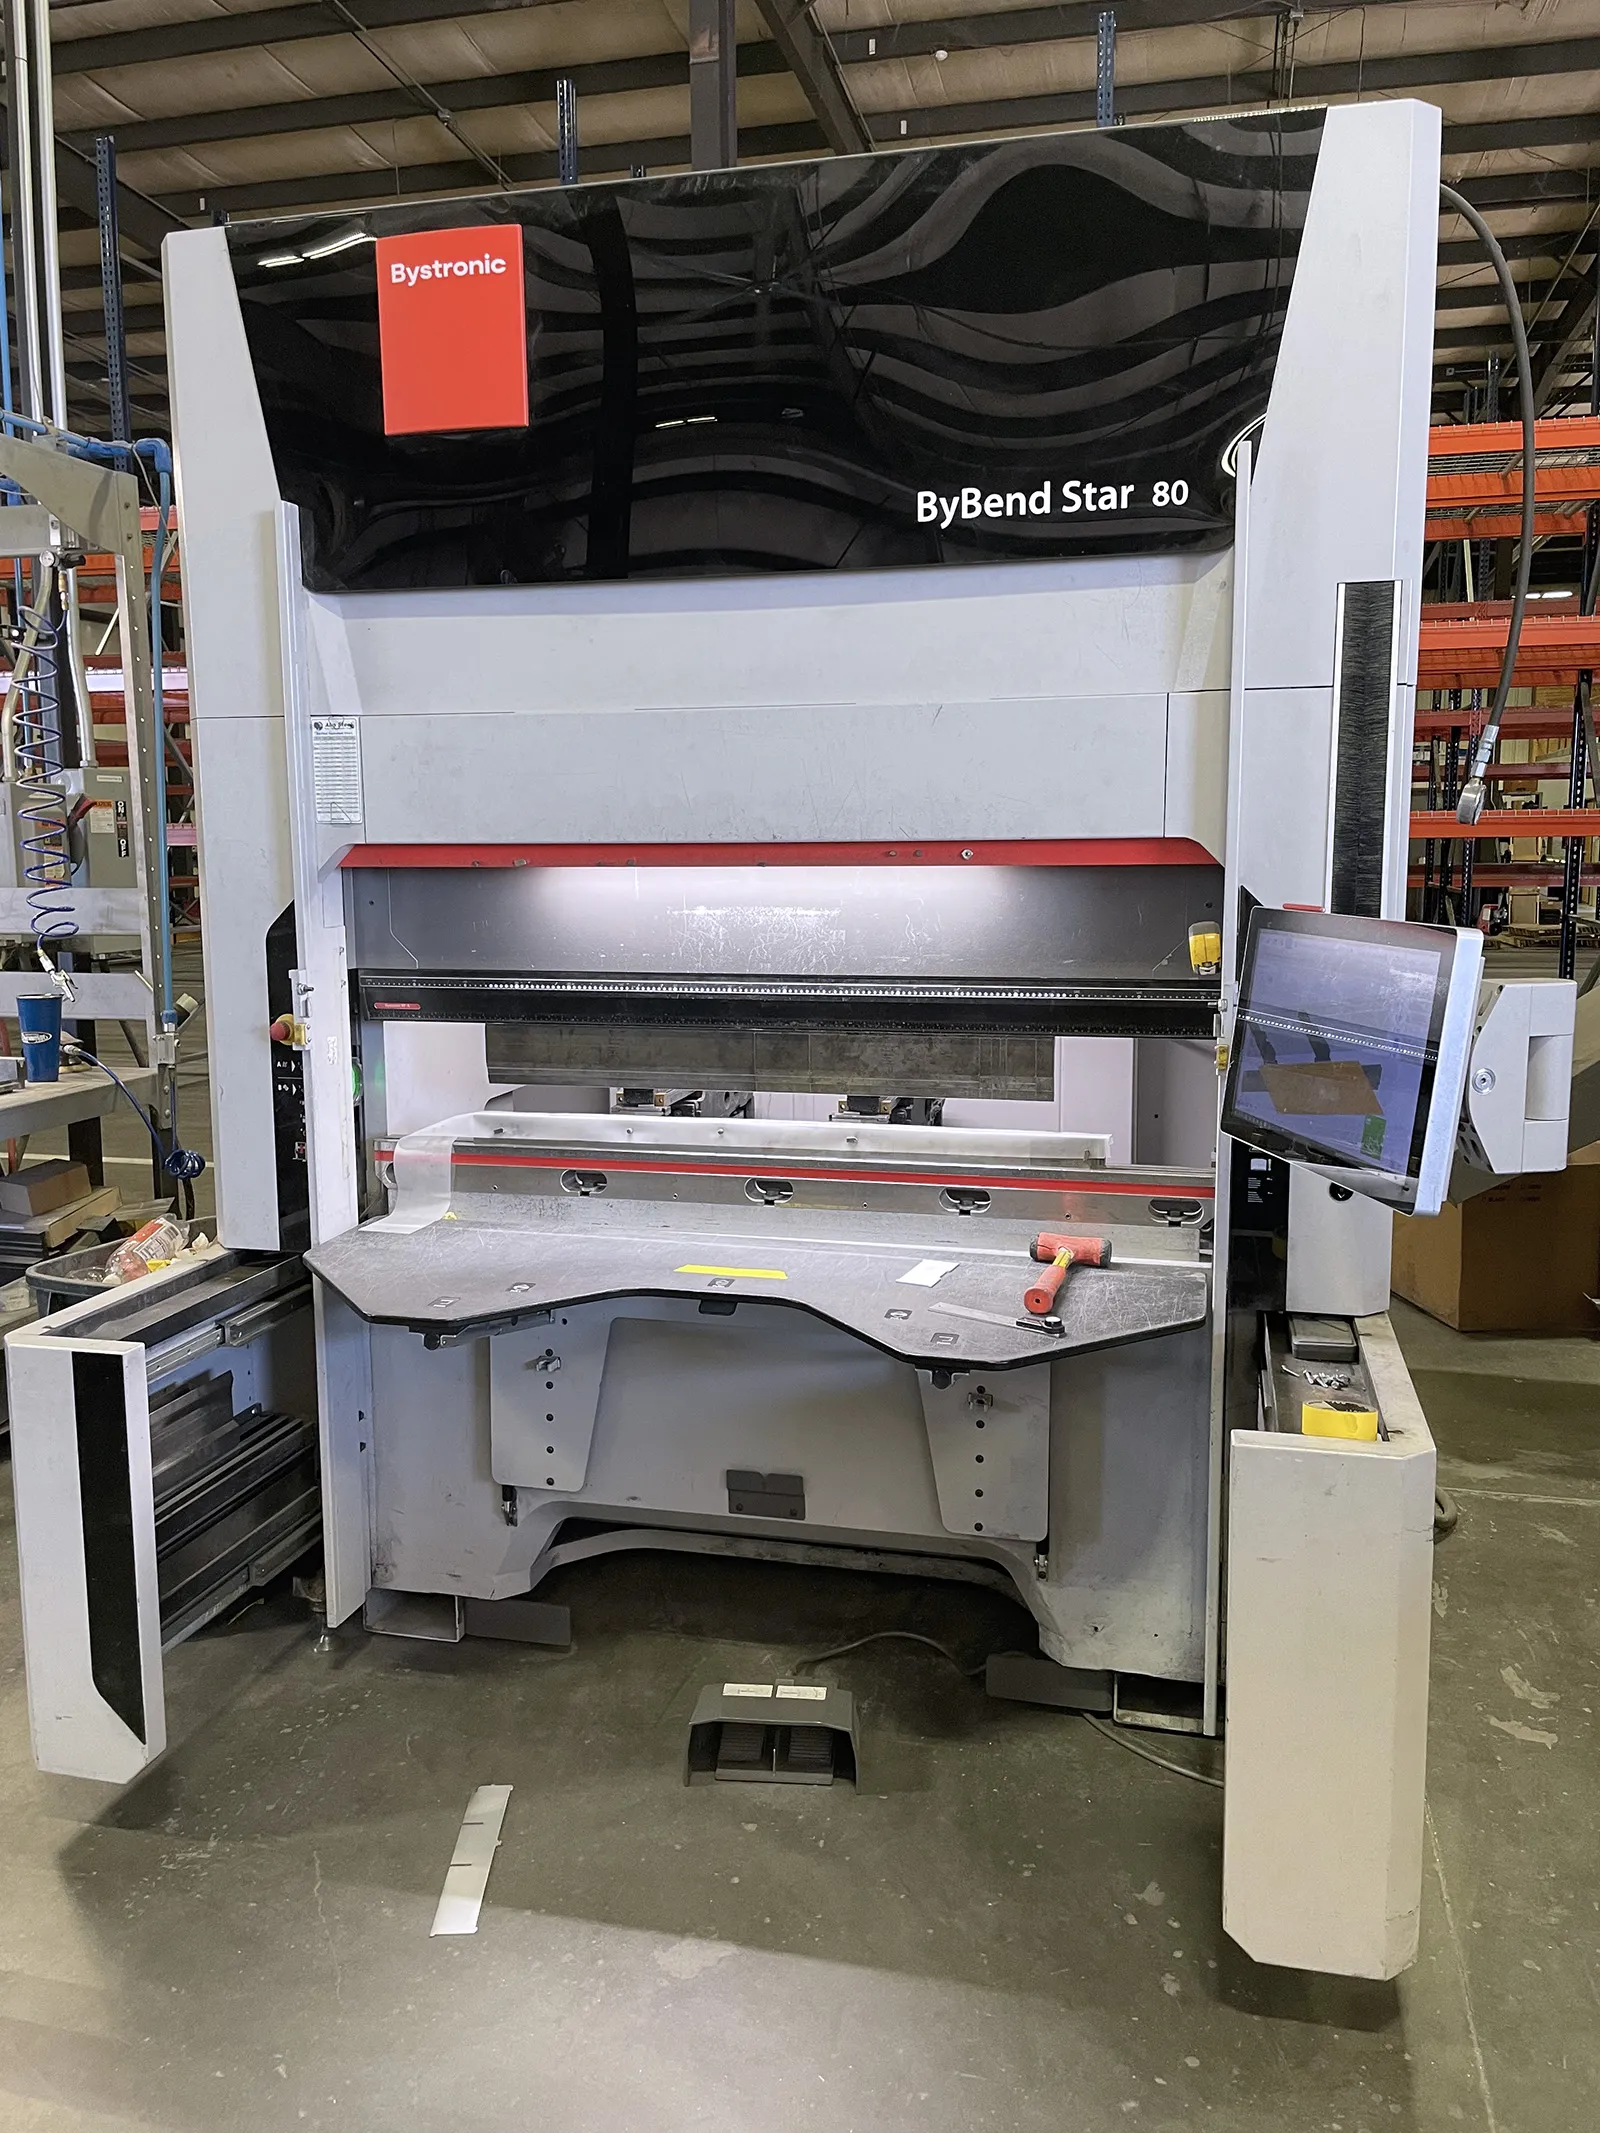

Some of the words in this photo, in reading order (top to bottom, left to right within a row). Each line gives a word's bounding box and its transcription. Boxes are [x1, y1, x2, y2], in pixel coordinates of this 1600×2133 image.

[390, 252, 507, 287] Bystronic
[916, 480, 1051, 530] ByBend
[1061, 480, 1135, 513] Star
[1151, 479, 1190, 507] 80
